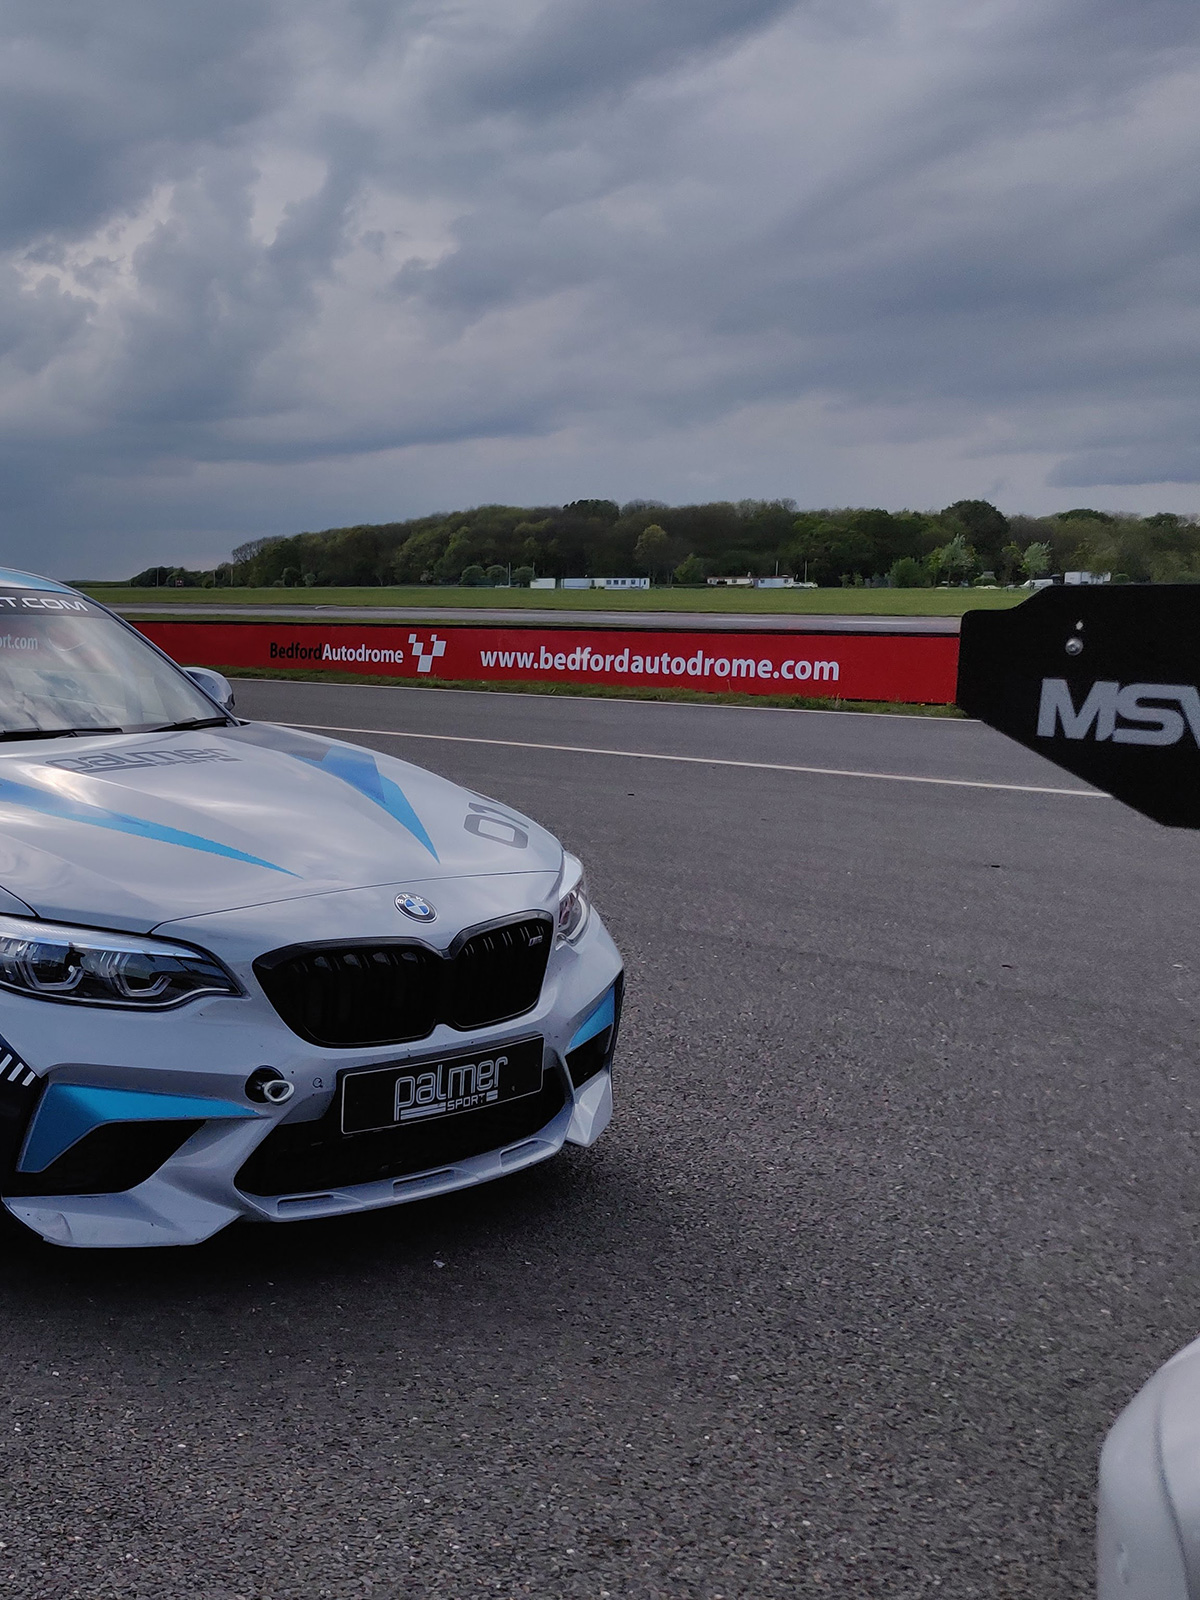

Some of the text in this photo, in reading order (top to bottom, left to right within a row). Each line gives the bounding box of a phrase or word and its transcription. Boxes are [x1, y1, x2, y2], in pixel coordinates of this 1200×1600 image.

[480, 646, 840, 681] www.bedfordautodrome.com
[463, 802, 529, 850] 01
[394, 1056, 509, 1122] palmer
[447, 1093, 486, 1111] SPORT
